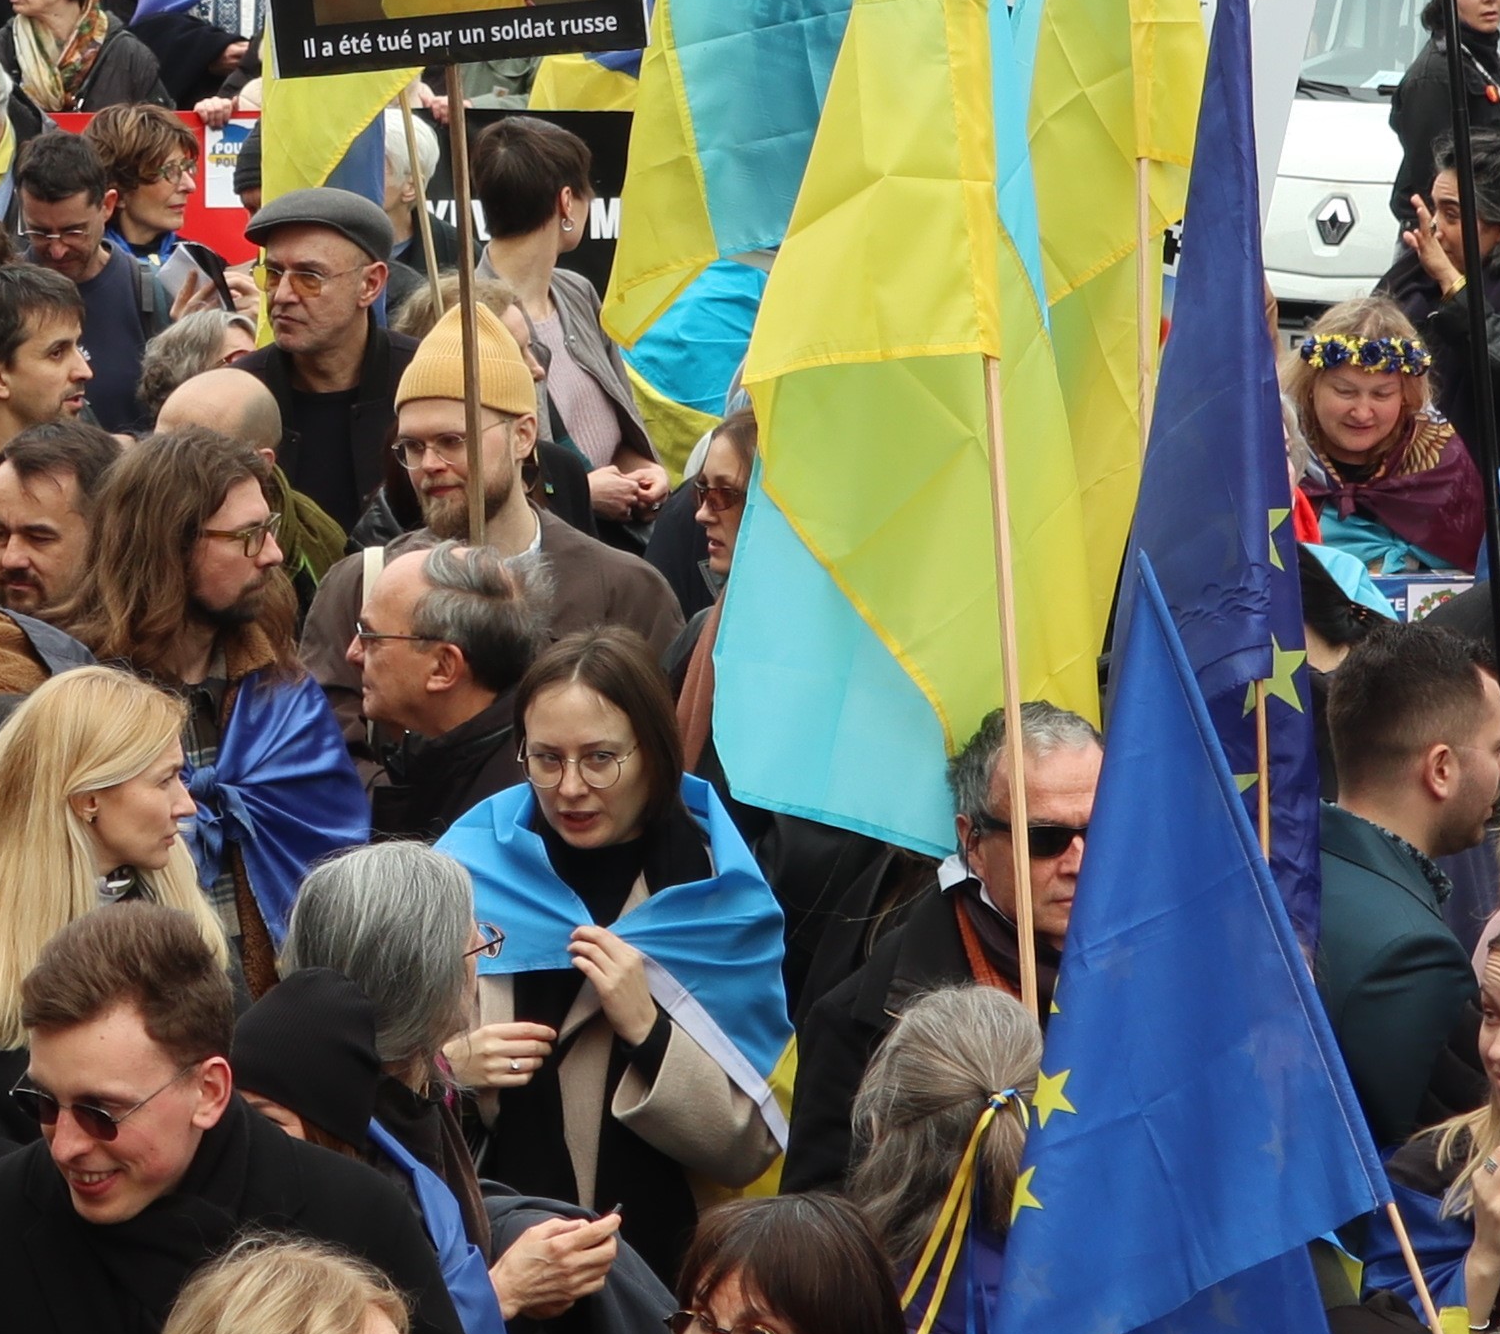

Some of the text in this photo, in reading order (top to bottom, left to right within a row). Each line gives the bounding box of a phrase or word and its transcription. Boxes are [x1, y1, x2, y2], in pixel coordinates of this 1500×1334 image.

[302, 14, 618, 59] Il a été tué par un soldat russe
